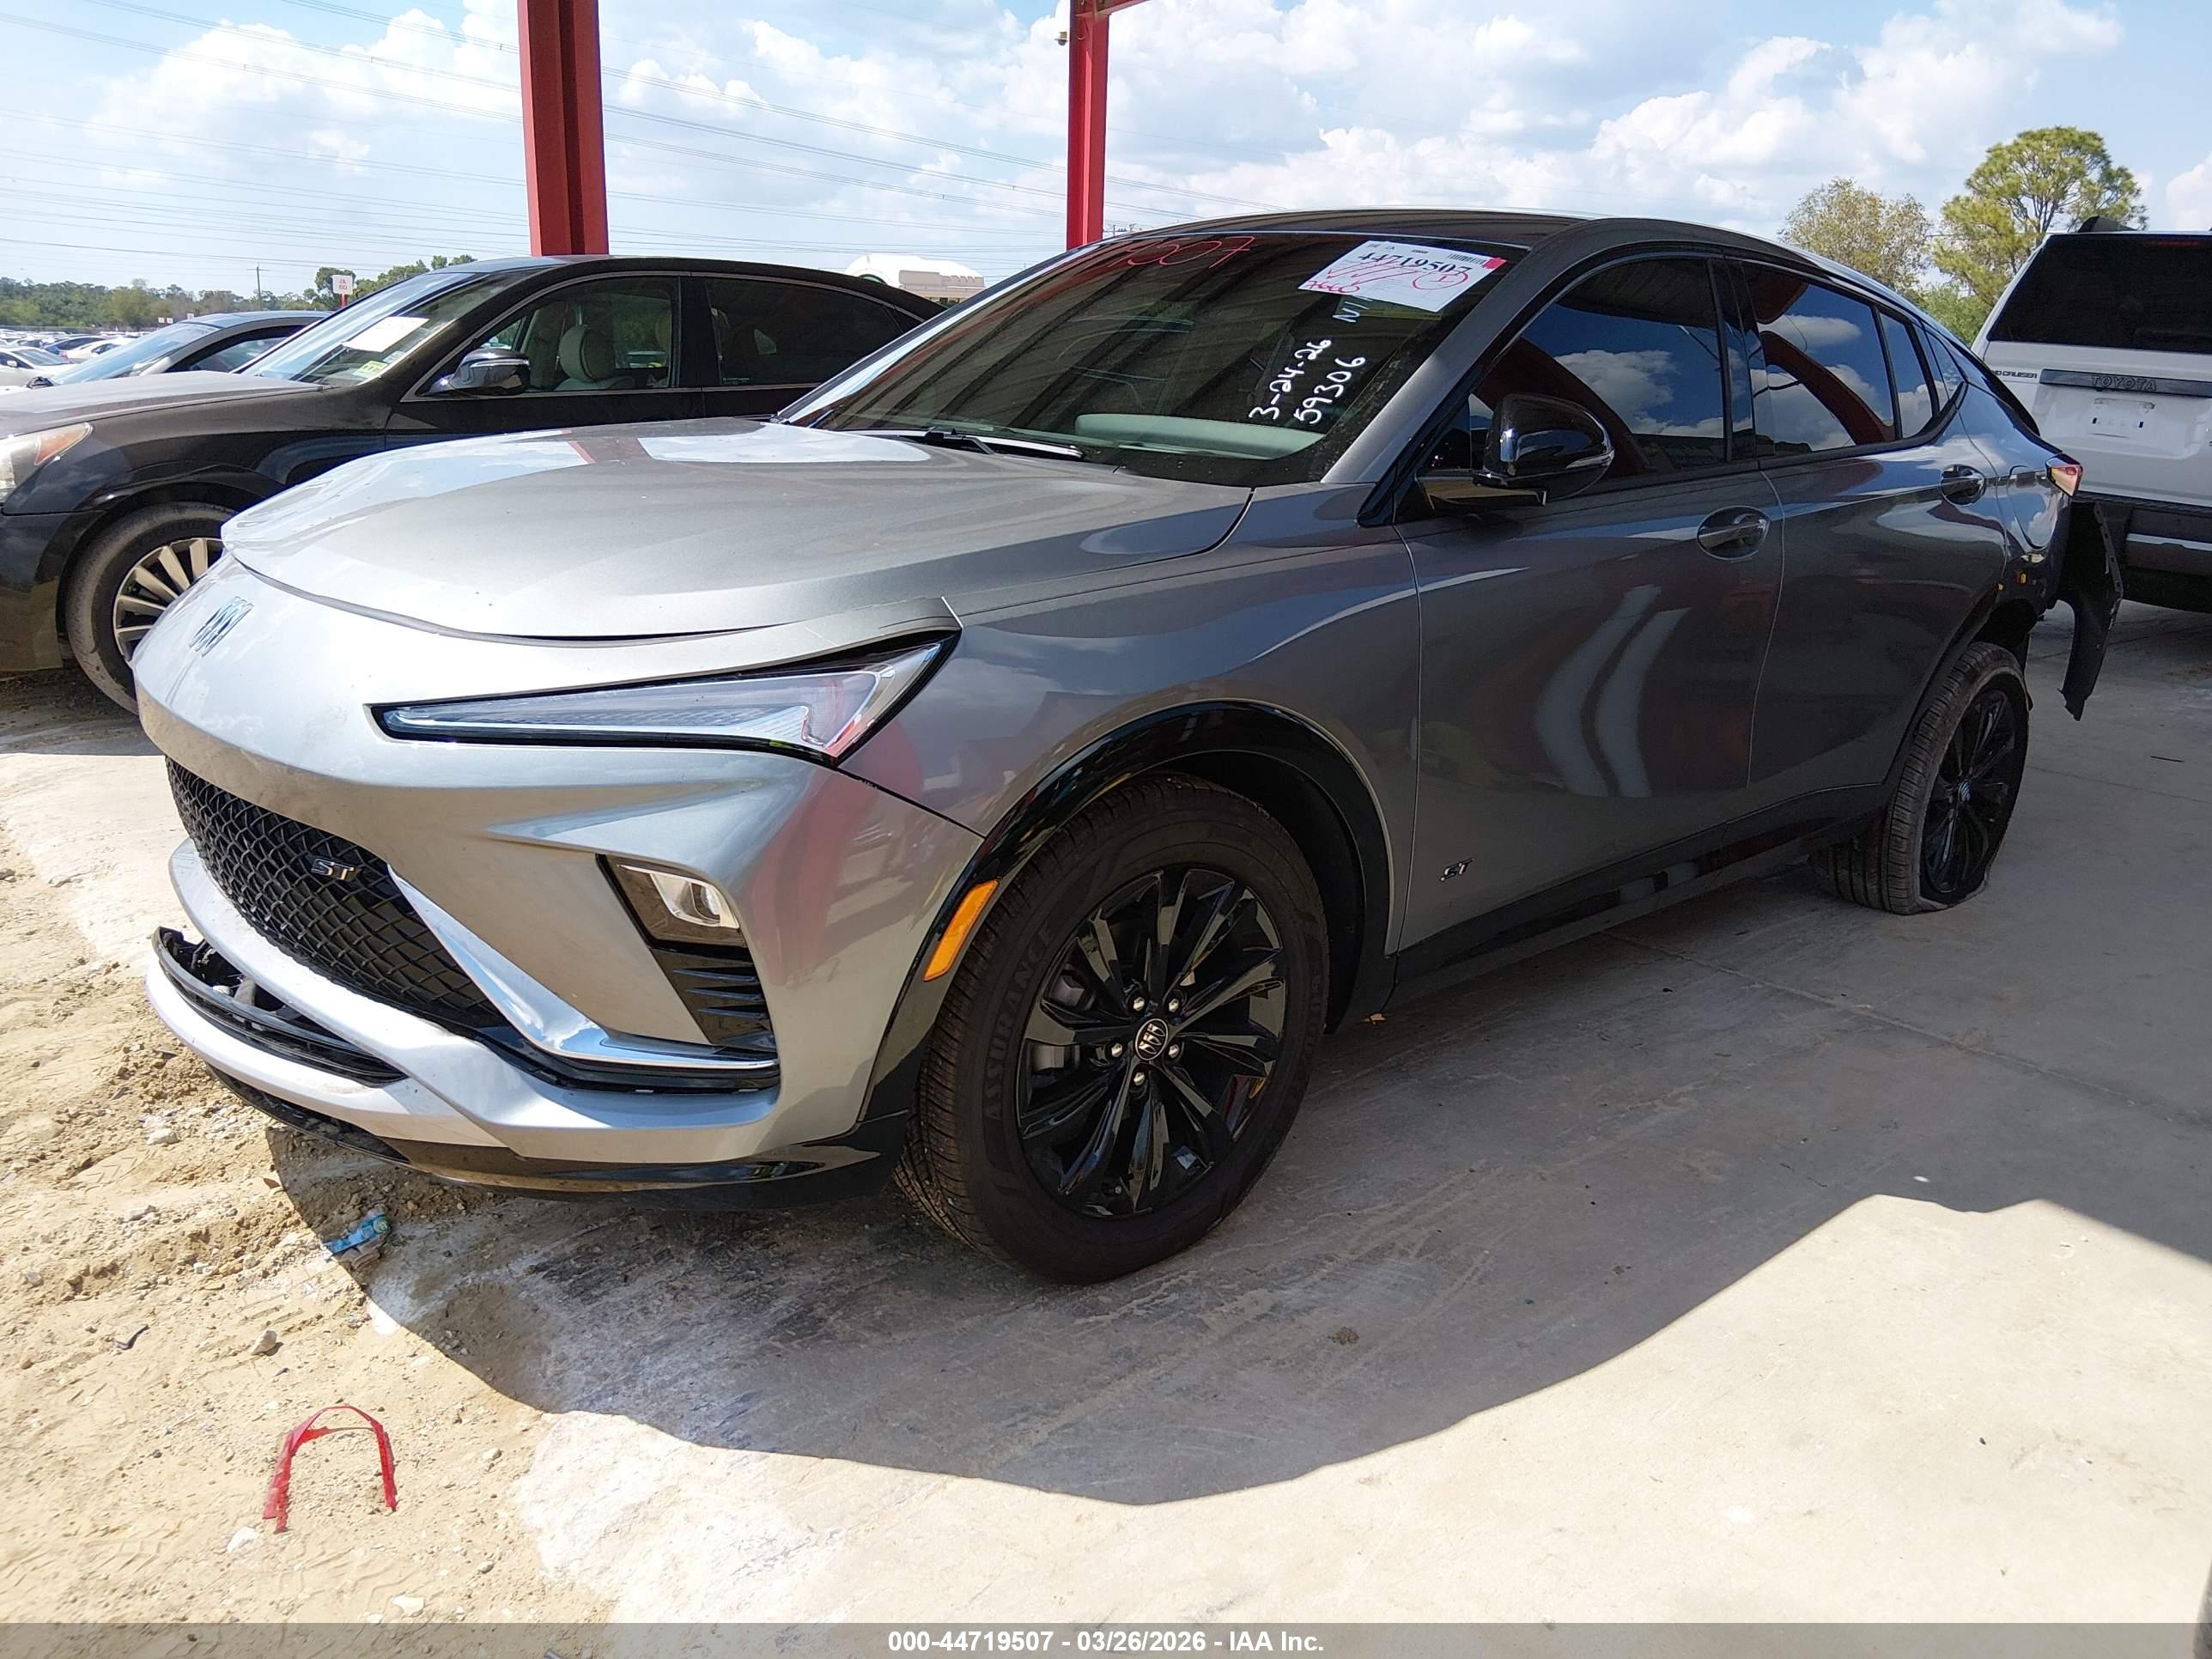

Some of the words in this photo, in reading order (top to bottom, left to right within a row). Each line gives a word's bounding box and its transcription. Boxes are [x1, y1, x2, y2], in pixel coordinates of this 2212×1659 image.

[1357, 252, 1474, 276] 44719507
[1249, 339, 1333, 420] 3-24-26
[1293, 356, 1366, 424] 59306
[2090, 374, 2158, 392] TOYOTA
